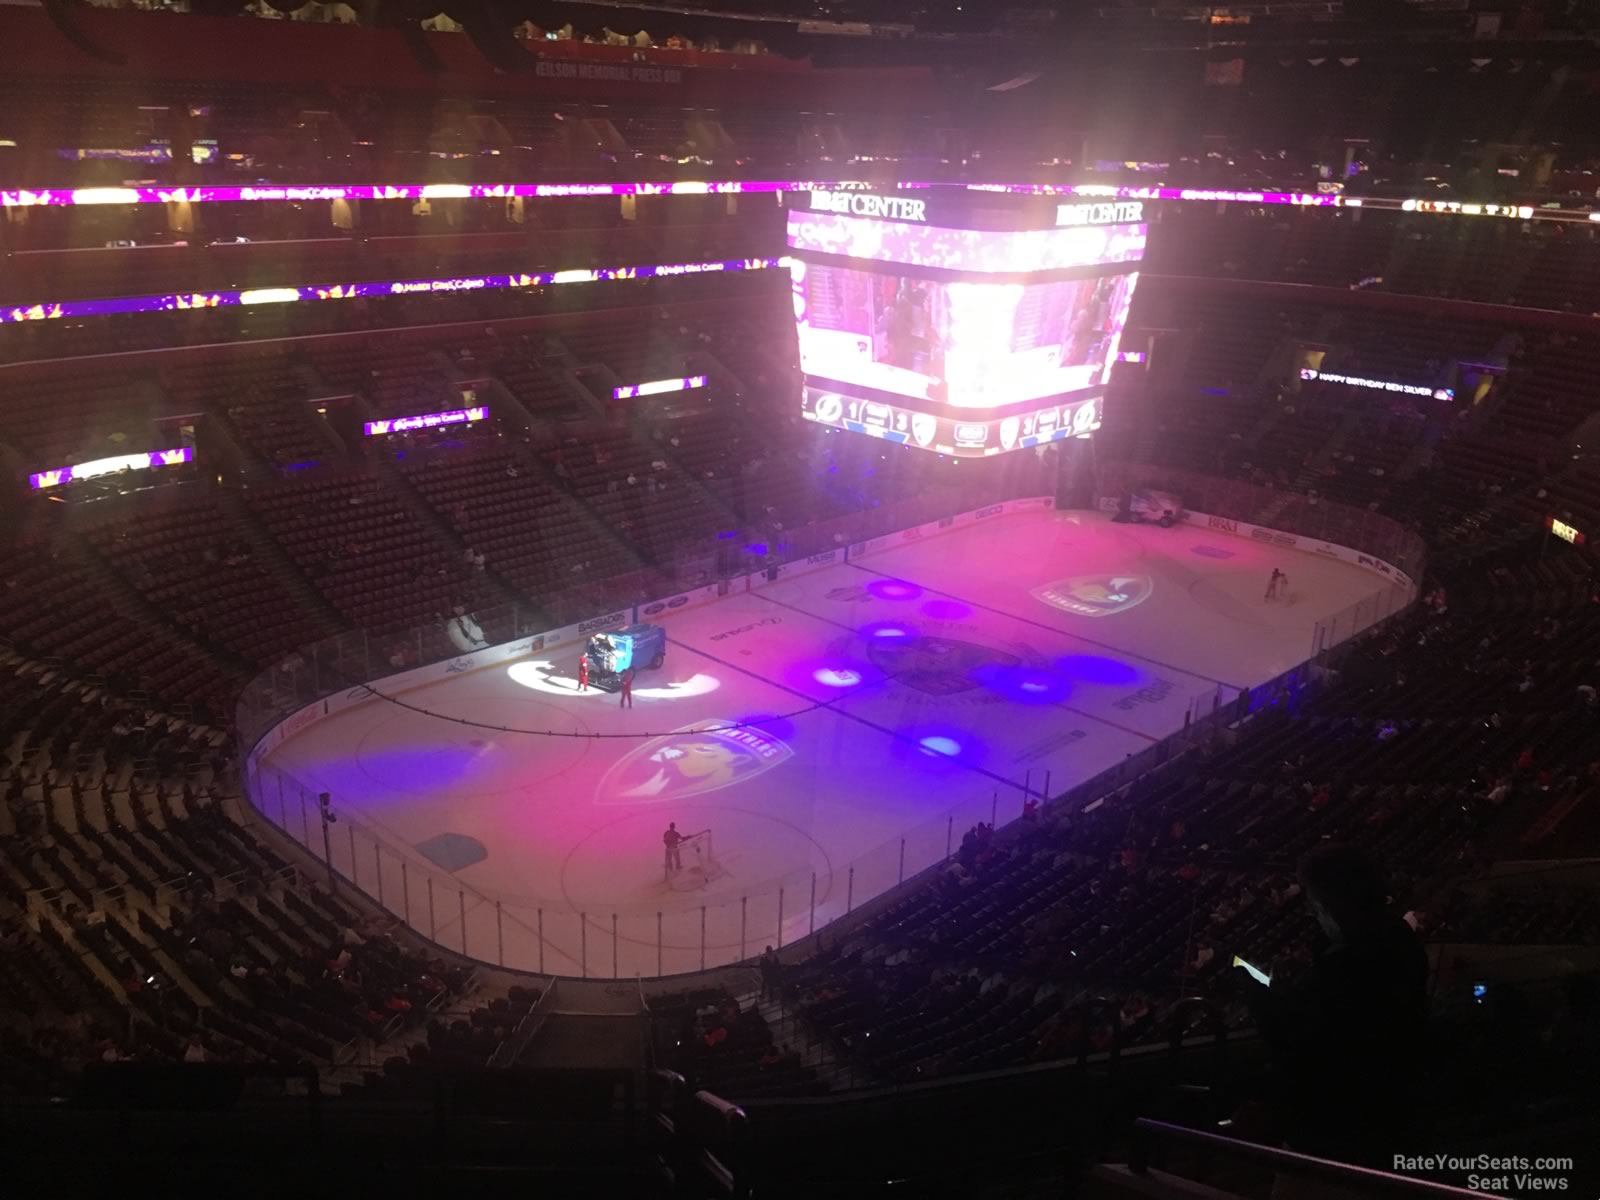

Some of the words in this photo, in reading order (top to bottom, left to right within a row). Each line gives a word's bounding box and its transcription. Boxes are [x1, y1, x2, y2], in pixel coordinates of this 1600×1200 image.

[851, 194, 926, 222] CENTER
[1088, 202, 1142, 224] CENTER
[1319, 373, 1346, 384] HAPPY
[1345, 376, 1386, 389] BIRTHDAY
[1385, 382, 1404, 392] BEN
[1403, 385, 1433, 396] SILVER
[848, 401, 858, 419] 1
[896, 413, 908, 431] 3
[1062, 409, 1072, 426] 1
